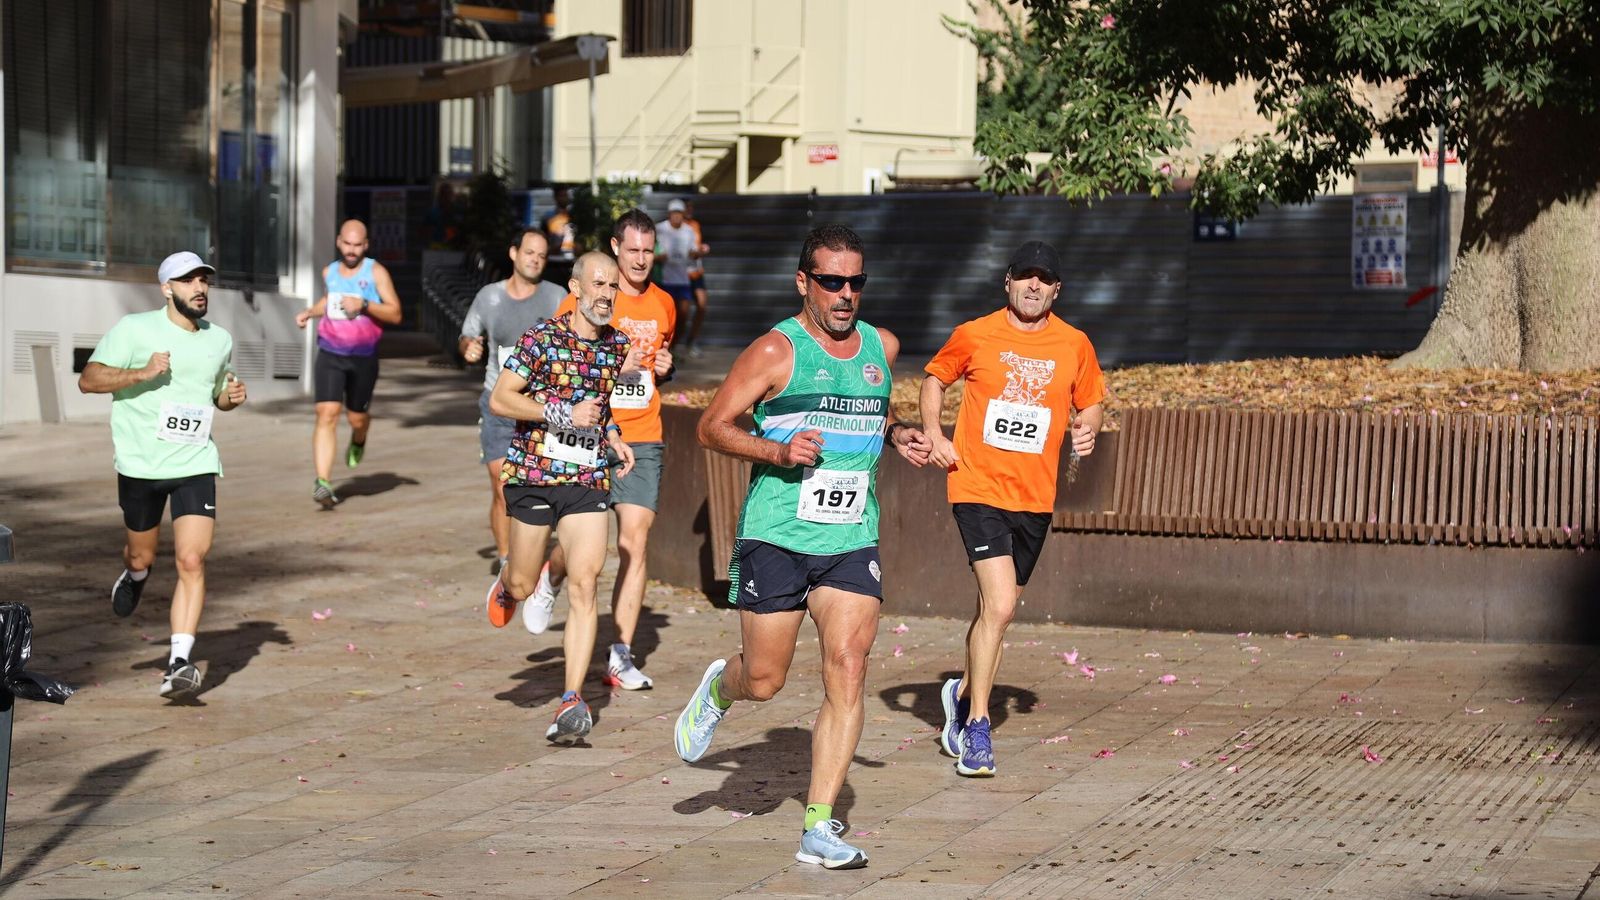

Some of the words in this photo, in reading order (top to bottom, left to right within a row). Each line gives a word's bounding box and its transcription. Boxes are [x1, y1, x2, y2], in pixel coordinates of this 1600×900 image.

[615, 384, 645, 396] 598
[819, 396, 881, 412] ATLETISMO
[166, 416, 201, 432] 897
[994, 418, 1038, 439] 622
[556, 431, 595, 451] 1012
[813, 488, 857, 508] 197
